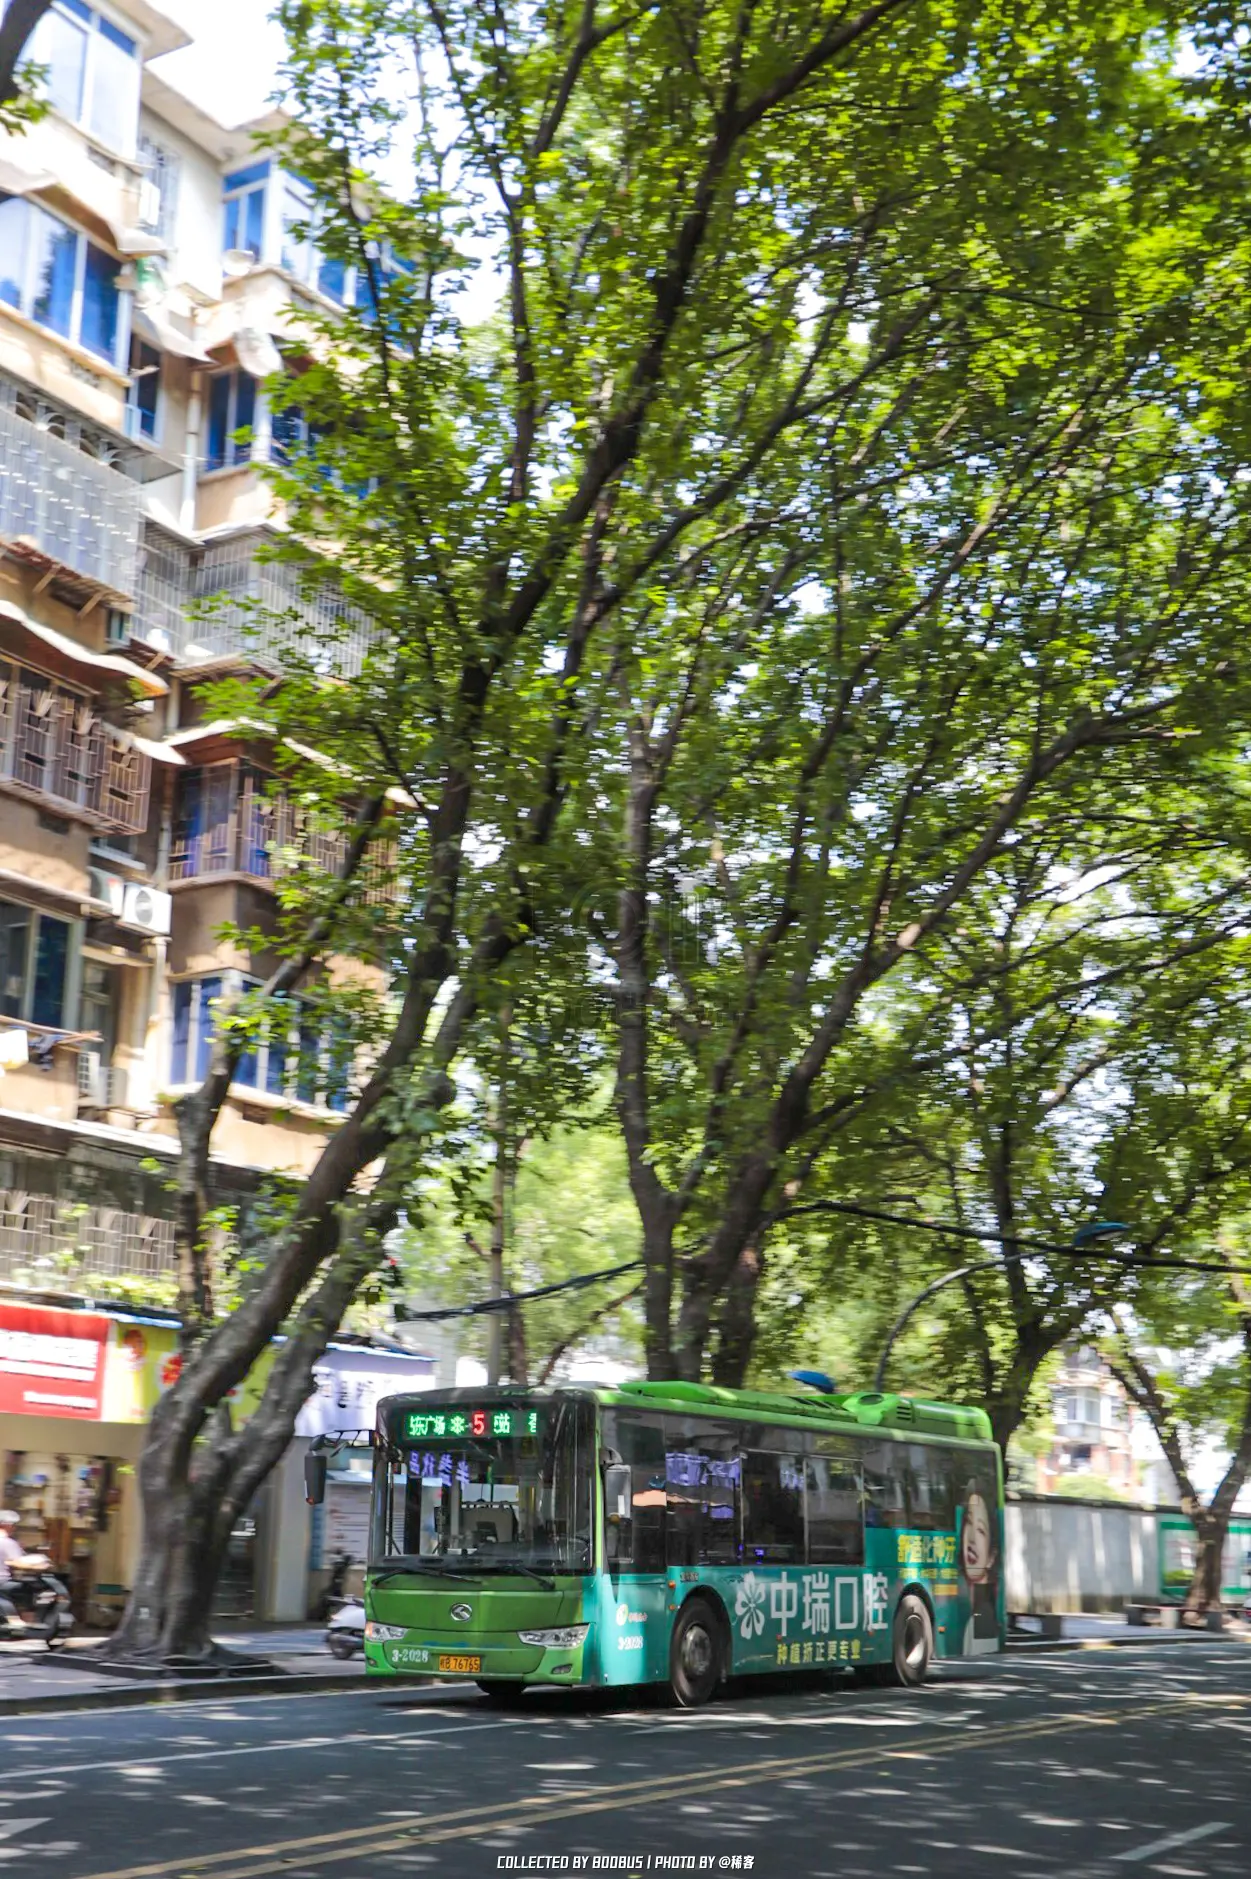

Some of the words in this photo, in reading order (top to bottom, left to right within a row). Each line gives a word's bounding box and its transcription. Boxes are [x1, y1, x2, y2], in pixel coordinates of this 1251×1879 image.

[473, 1413, 485, 1435] 5
[770, 1571, 889, 1637] 中瑞口腔
[392, 1648, 429, 1663] 3-2028
